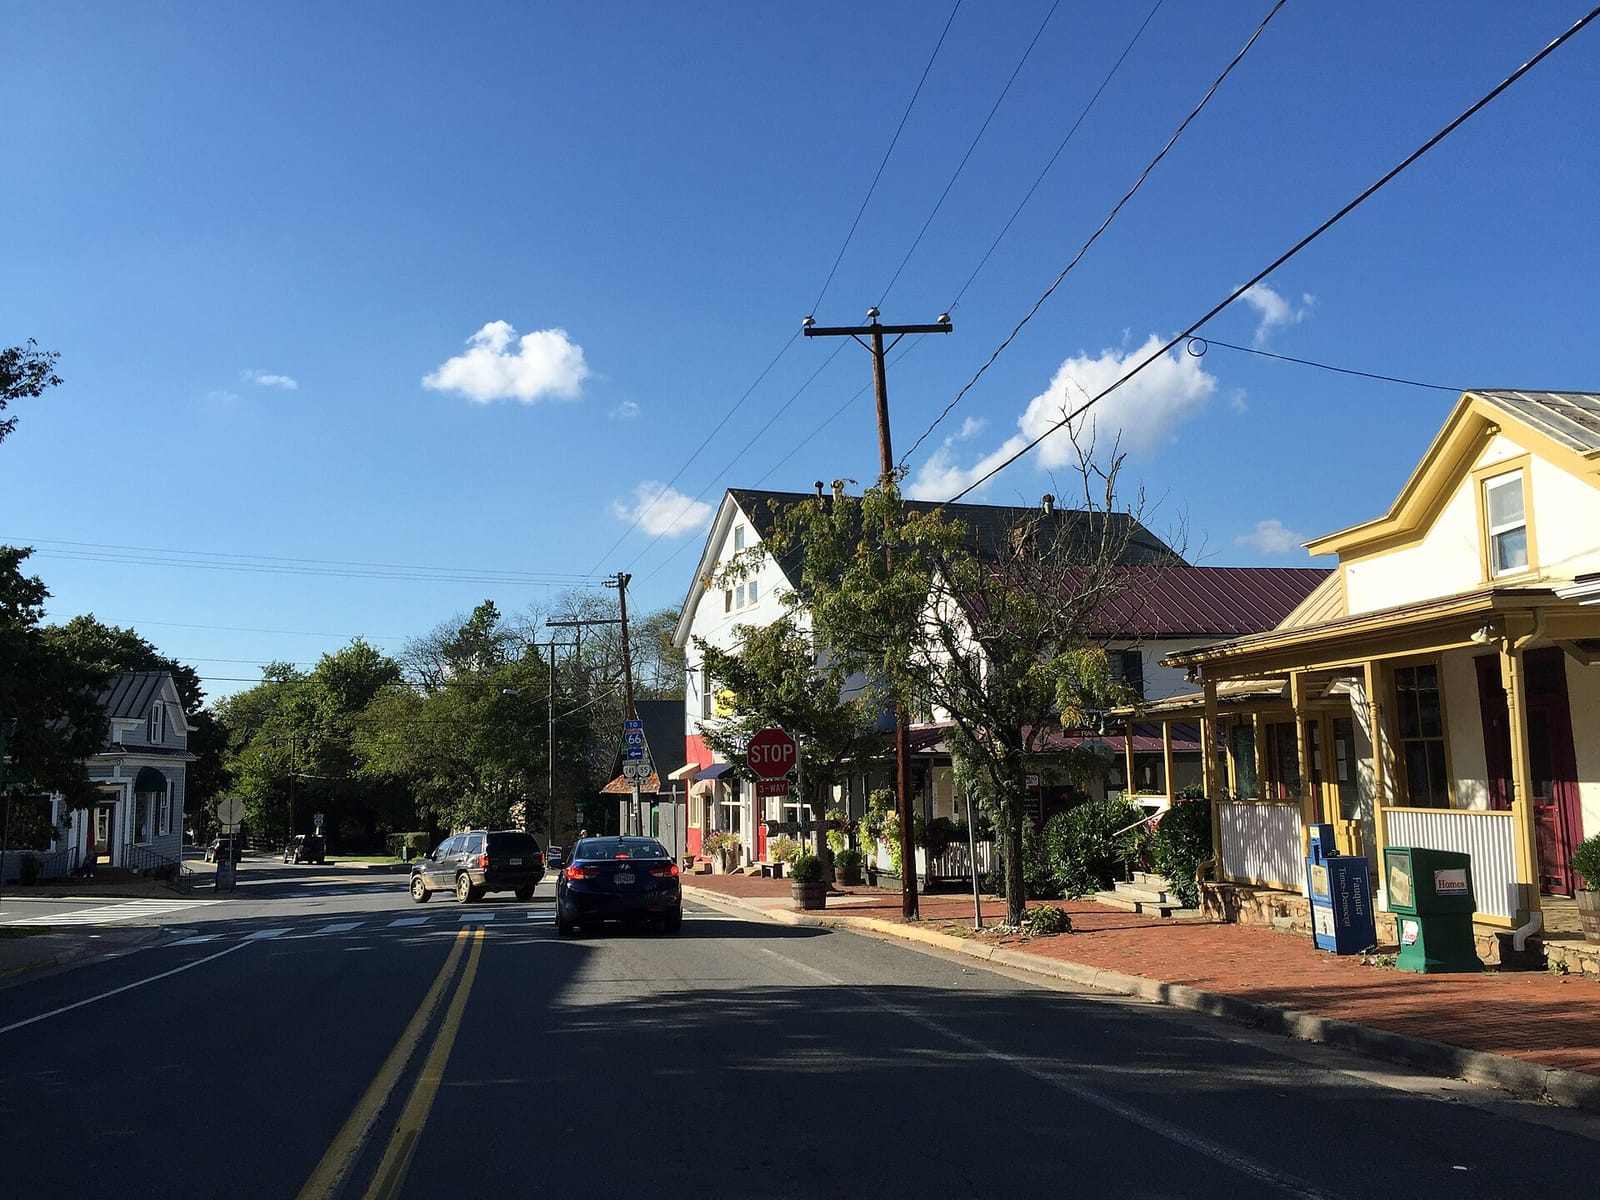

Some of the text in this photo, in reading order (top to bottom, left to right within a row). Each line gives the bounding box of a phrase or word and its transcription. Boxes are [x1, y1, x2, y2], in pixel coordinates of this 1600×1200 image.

[628, 734, 641, 744] 66
[751, 745, 793, 763] STOP
[759, 784, 786, 794] 3-WAY
[1438, 880, 1465, 889] Homes
[1352, 877, 1365, 916] Fauquier
